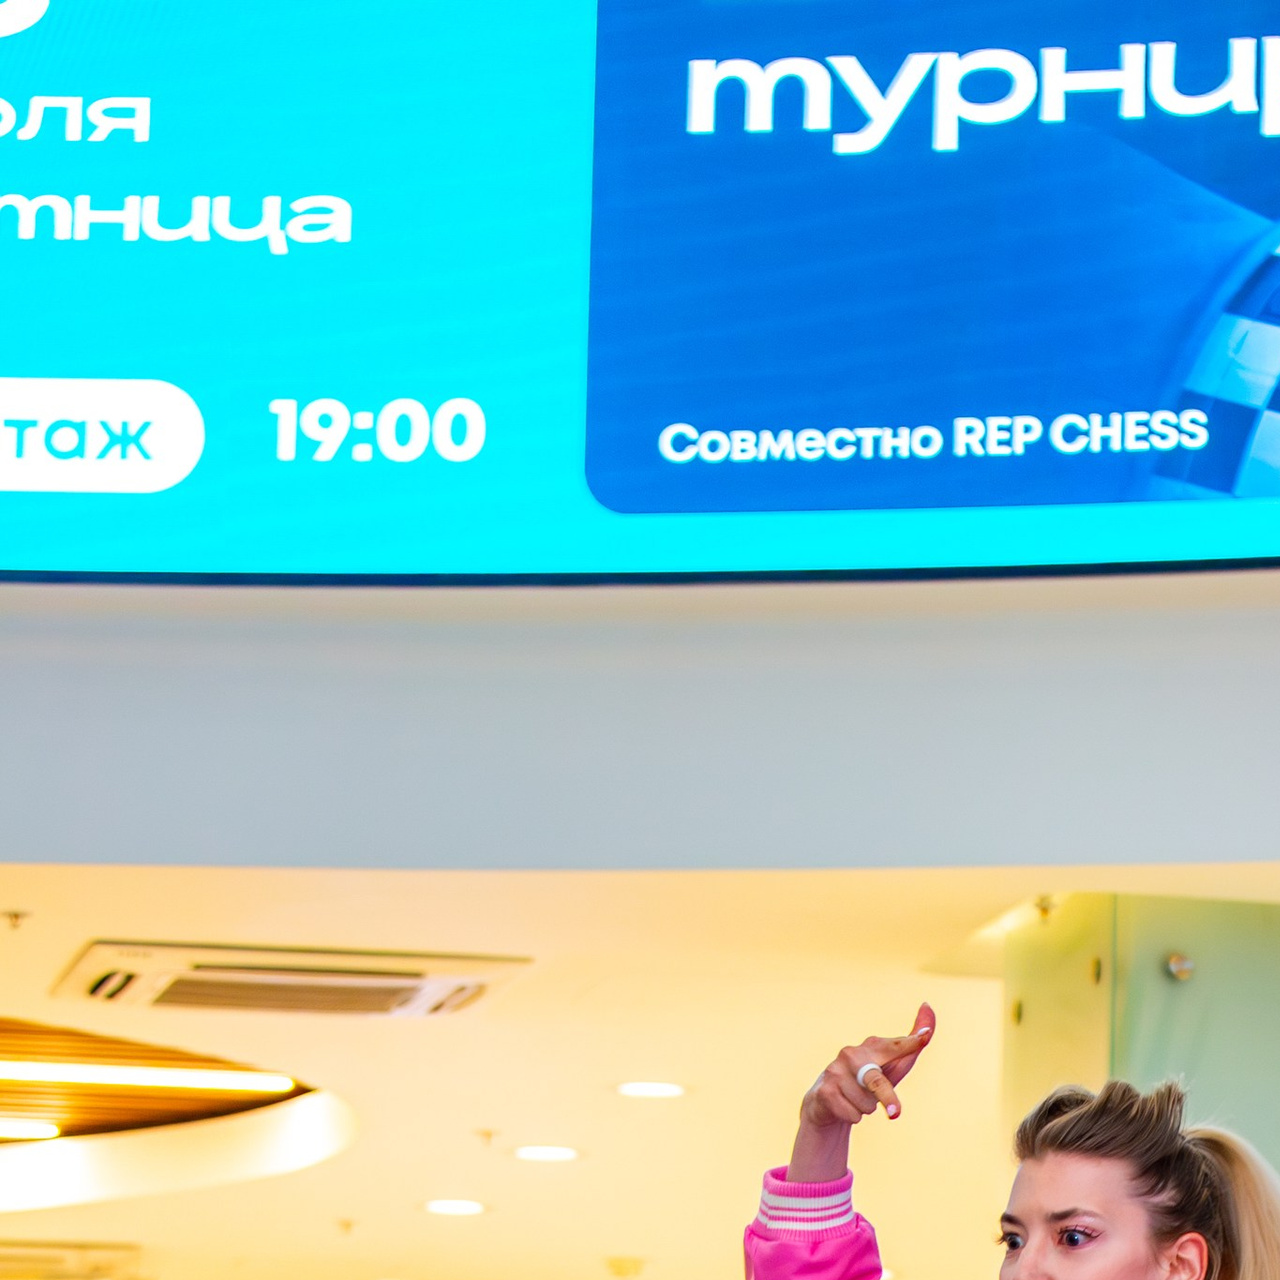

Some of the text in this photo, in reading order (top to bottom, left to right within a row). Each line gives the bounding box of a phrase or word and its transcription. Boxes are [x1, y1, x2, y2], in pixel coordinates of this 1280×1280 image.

[0, 95, 151, 142] ля
[268, 397, 486, 462] 19:00
[658, 410, 1209, 463] Совместно REP CHESS
